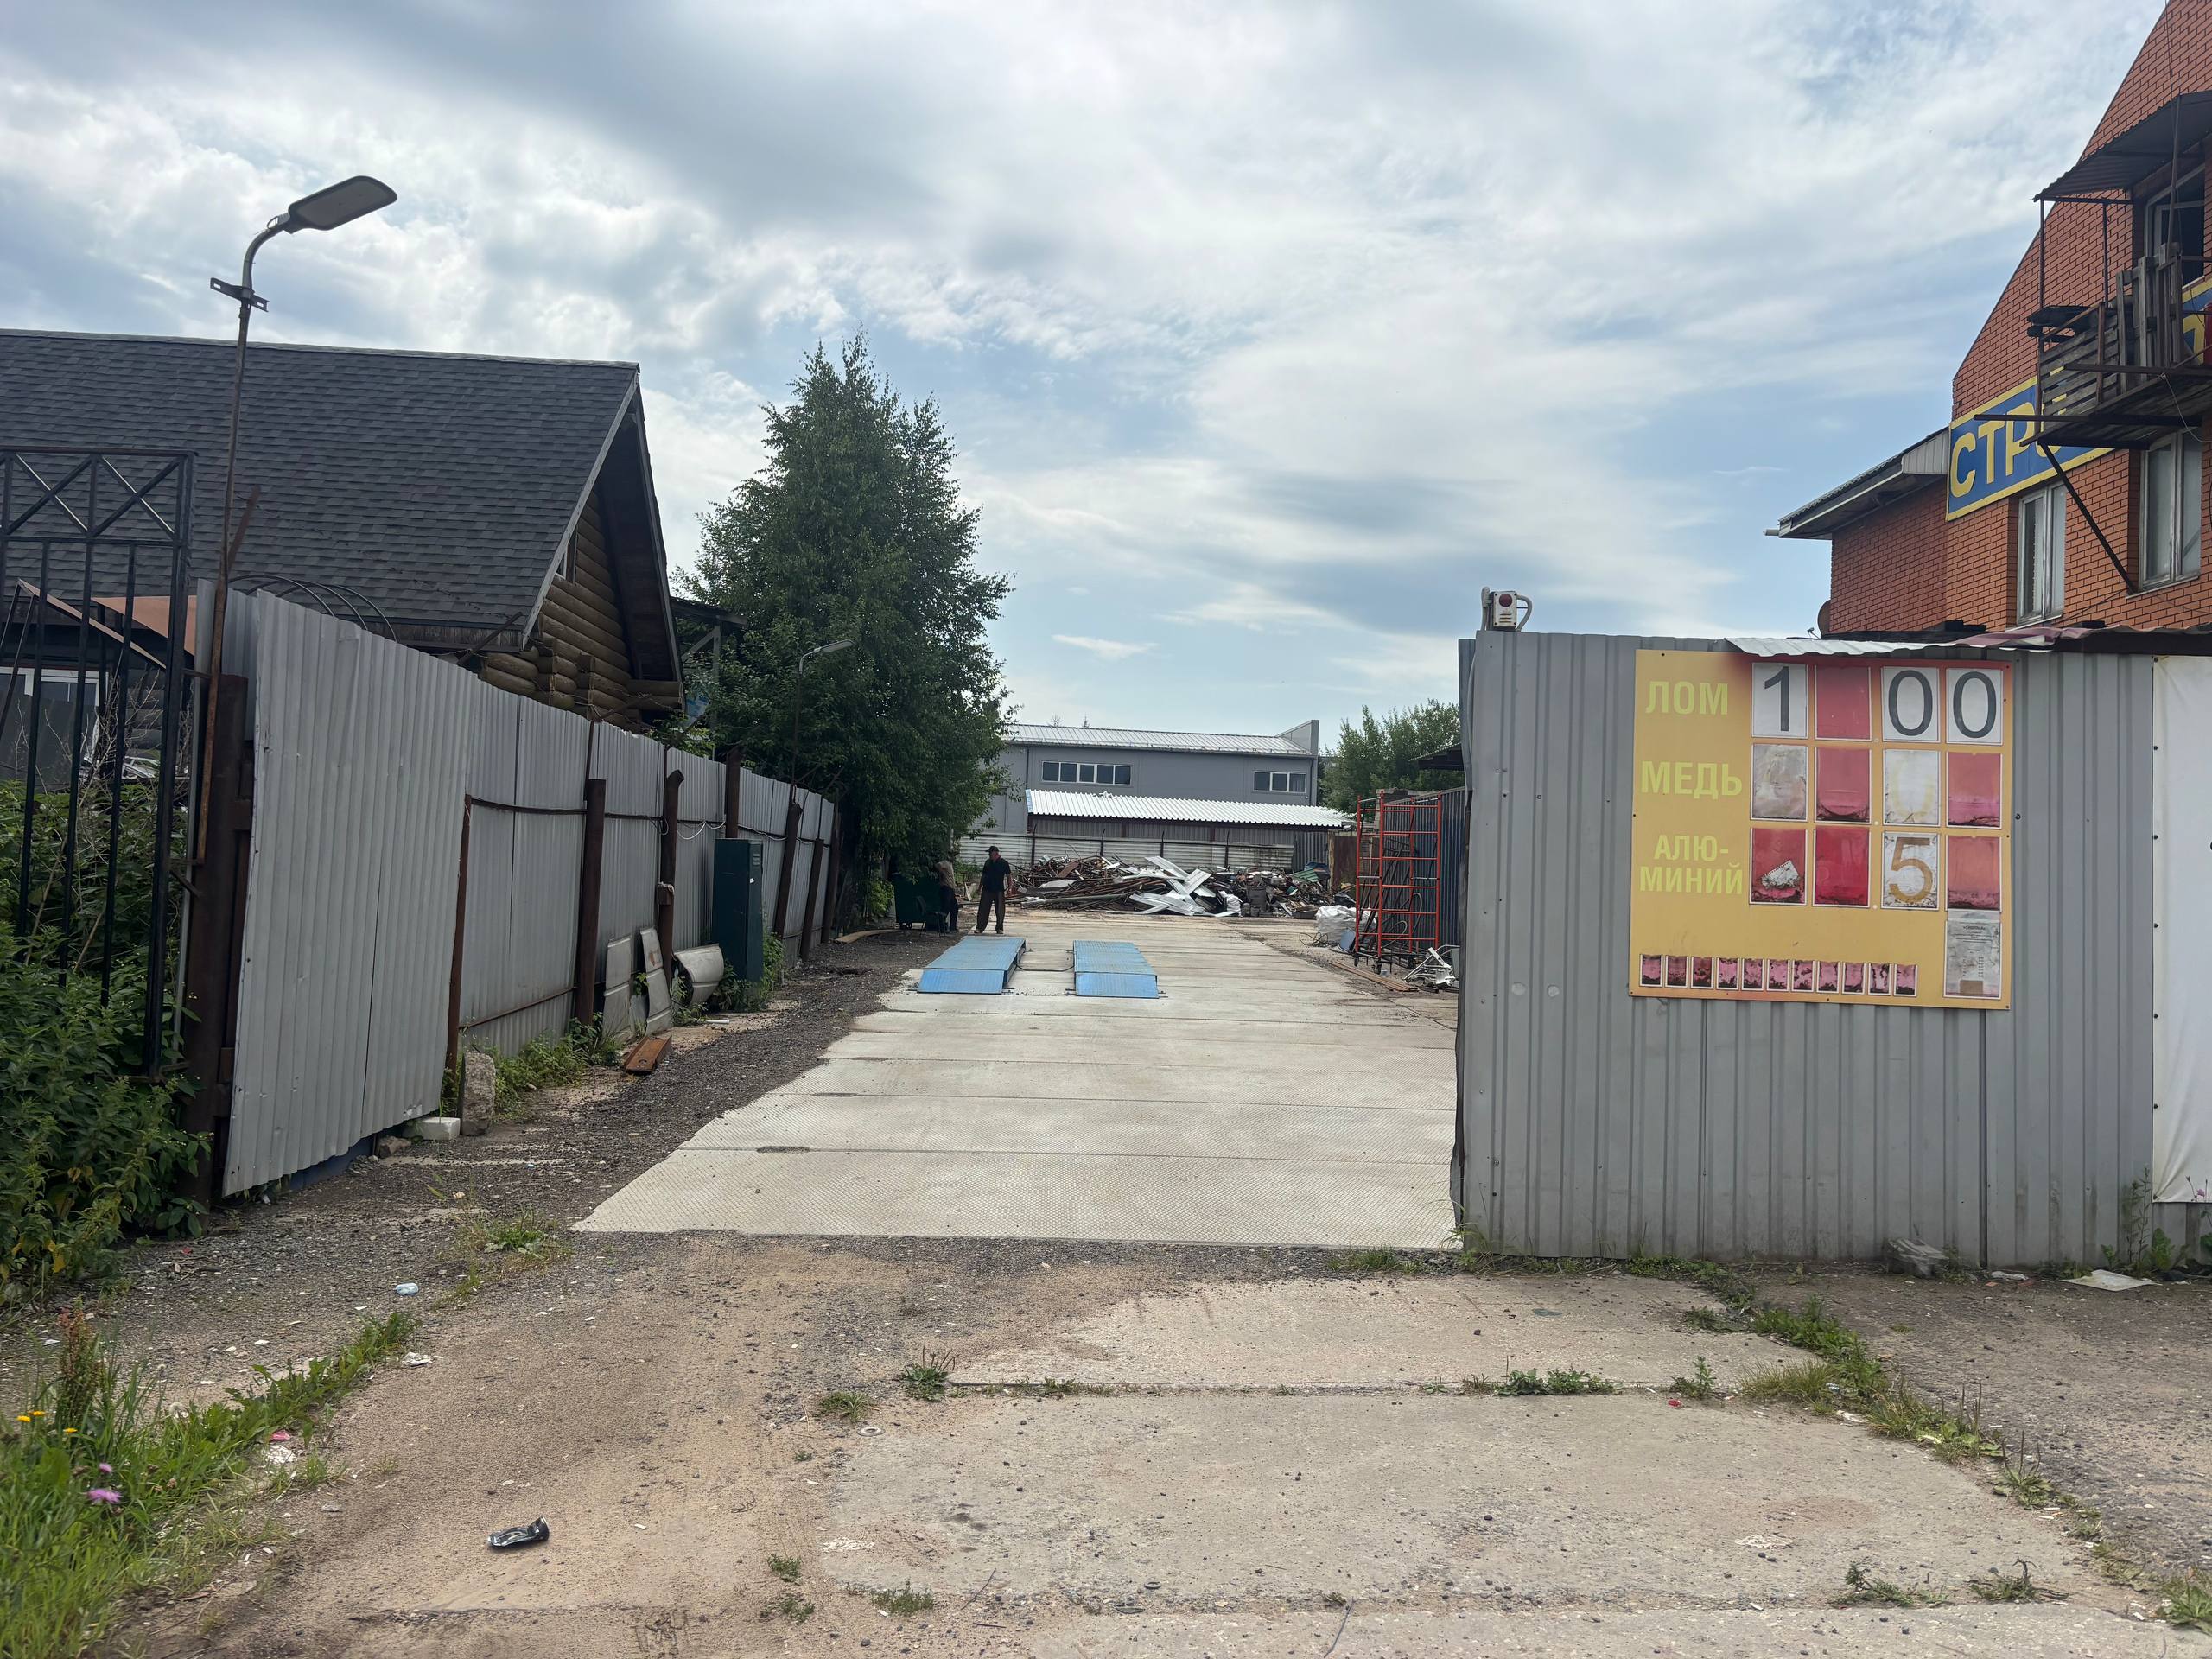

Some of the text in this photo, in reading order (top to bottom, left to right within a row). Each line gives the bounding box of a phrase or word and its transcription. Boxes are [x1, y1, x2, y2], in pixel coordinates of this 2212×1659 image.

[1645, 681, 1727, 715] ЛОМ
[1642, 761, 1742, 798] МЕДЬ
[1654, 835, 1728, 861] АЛЮ-
[1640, 838, 1933, 904] МИНИЙ 5
